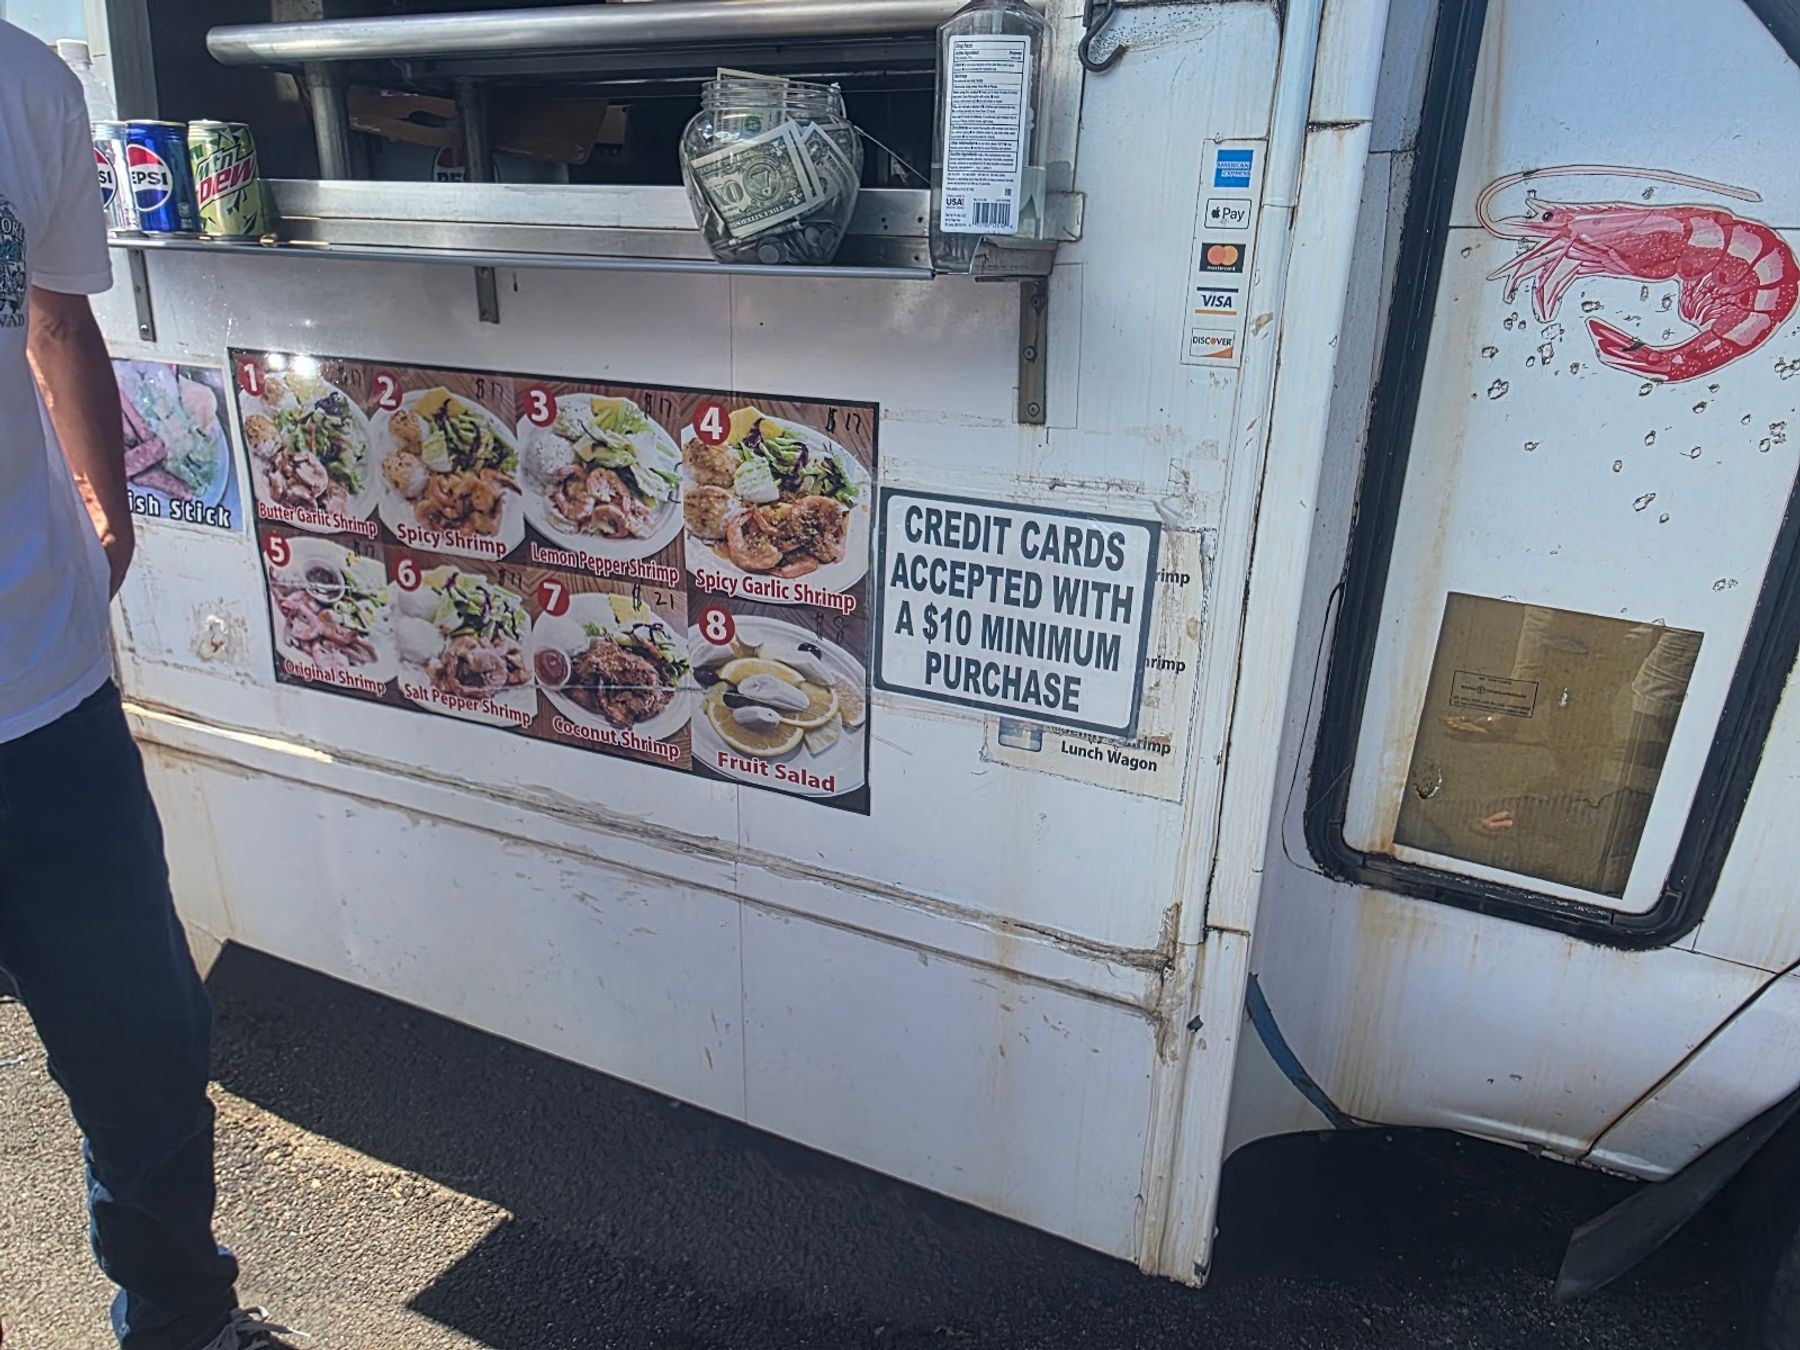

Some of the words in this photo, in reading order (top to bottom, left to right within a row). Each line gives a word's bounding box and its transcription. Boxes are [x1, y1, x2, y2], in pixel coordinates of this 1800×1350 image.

[98, 170, 112, 184] SI
[131, 171, 169, 185] EPSI
[946, 198, 962, 206] USA
[1222, 207, 1245, 222] Pay
[1201, 294, 1232, 308] VISA
[1192, 336, 1233, 346] DISCOVER
[243, 363, 257, 391] 1
[378, 376, 397, 406] 2
[530, 390, 549, 422] 3
[700, 407, 723, 440] 4
[128, 491, 160, 515] ish
[170, 499, 231, 528] Stick
[259, 503, 294, 520] Butter
[297, 508, 331, 527] Garlic
[333, 514, 377, 538] Shrimp
[269, 537, 283, 562] 5
[397, 524, 440, 547] Spicy
[445, 531, 507, 556] Shrimp
[905, 505, 1011, 555] CREDIT
[1020, 520, 1126, 571] CARDS
[398, 559, 416, 587] 6
[531, 543, 576, 566] Lemon
[580, 551, 628, 576] Pepper
[629, 558, 679, 587] Shrimp
[1155, 568, 1190, 587] rimp
[543, 582, 562, 611] 7
[696, 569, 738, 596] Spicy
[742, 576, 789, 599] Garlic
[794, 584, 856, 614] Shrimp
[890, 552, 1042, 609] ACCEPTED
[1053, 575, 1134, 624] WITH
[706, 610, 727, 640] 8
[894, 600, 914, 637] A
[922, 602, 972, 644] $10
[981, 613, 1122, 672] MINIMUM
[285, 659, 335, 682] Original
[339, 673, 387, 697] Shrimp
[1147, 655, 1186, 675] rimp
[925, 650, 1082, 713] PURCHASE
[405, 684, 428, 700] Salt
[432, 691, 479, 711] Pepper
[482, 699, 532, 727] Shrimp
[553, 716, 616, 743] Coconut
[620, 732, 681, 760] Shrimp
[1061, 740, 1103, 761] Lunch
[1107, 750, 1157, 771] Wagon
[717, 751, 769, 776] Fruit
[774, 763, 835, 793] Salad
